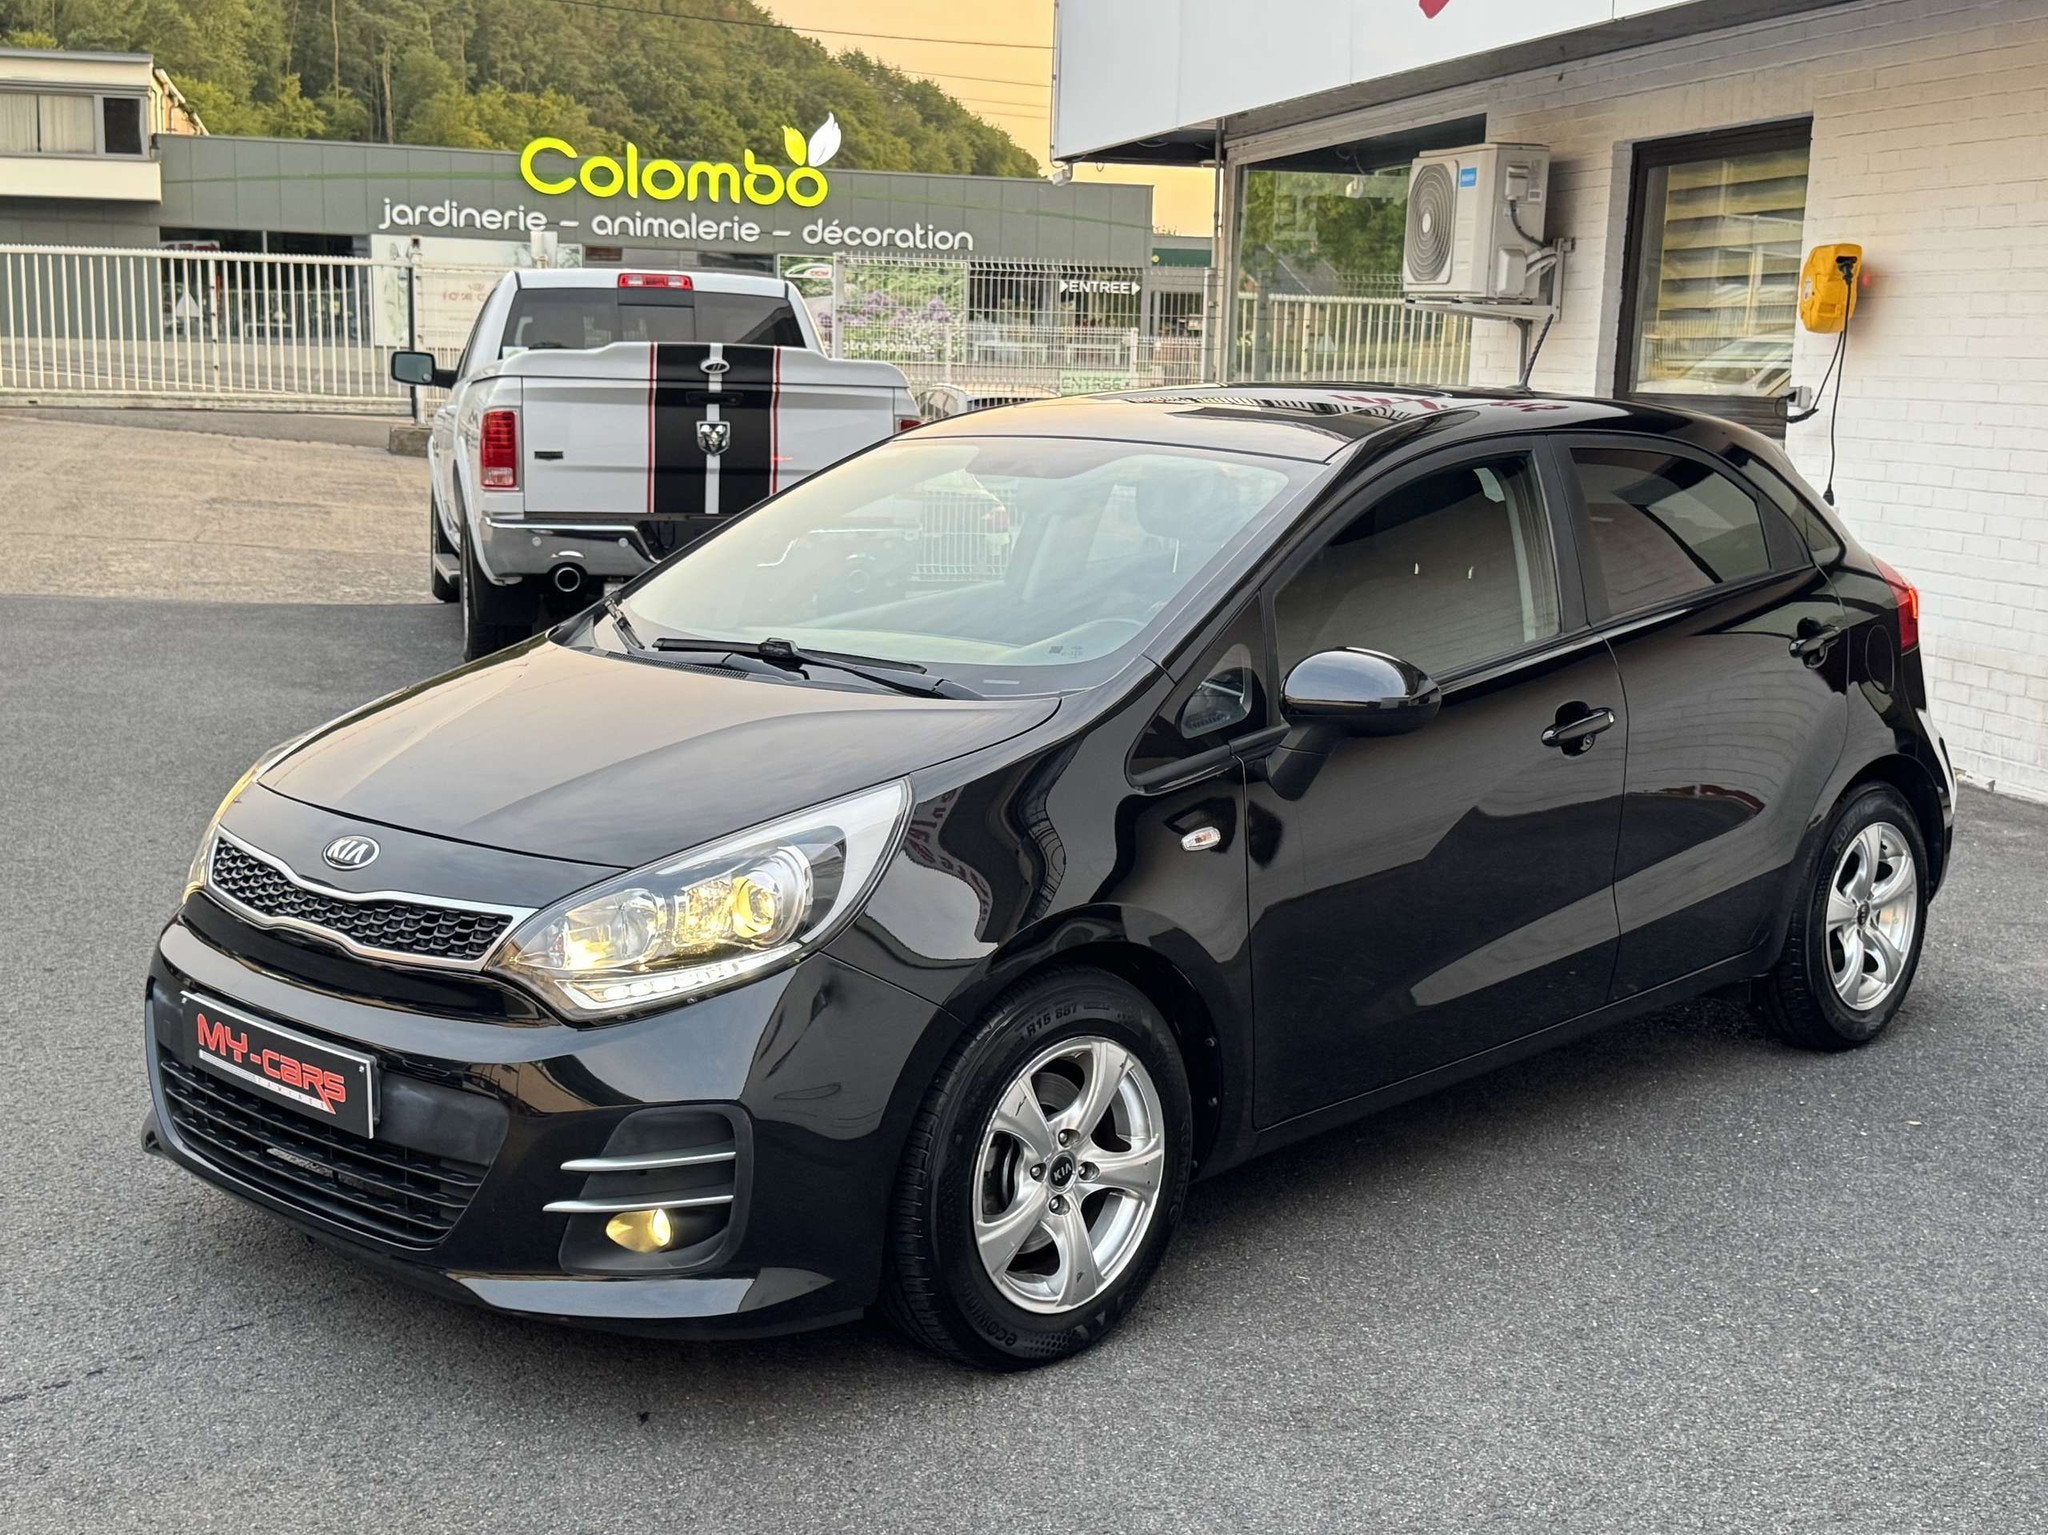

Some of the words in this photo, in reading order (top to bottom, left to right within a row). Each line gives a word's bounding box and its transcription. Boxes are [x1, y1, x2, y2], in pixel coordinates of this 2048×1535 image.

[520, 137, 828, 207] Colombo
[378, 198, 547, 231] jardinerie
[591, 211, 760, 242] animalerie
[802, 218, 973, 250] décoration
[1069, 281, 1131, 294] ENTREE
[327, 839, 369, 864] KIA
[1054, 1163, 1072, 1181] KIA
